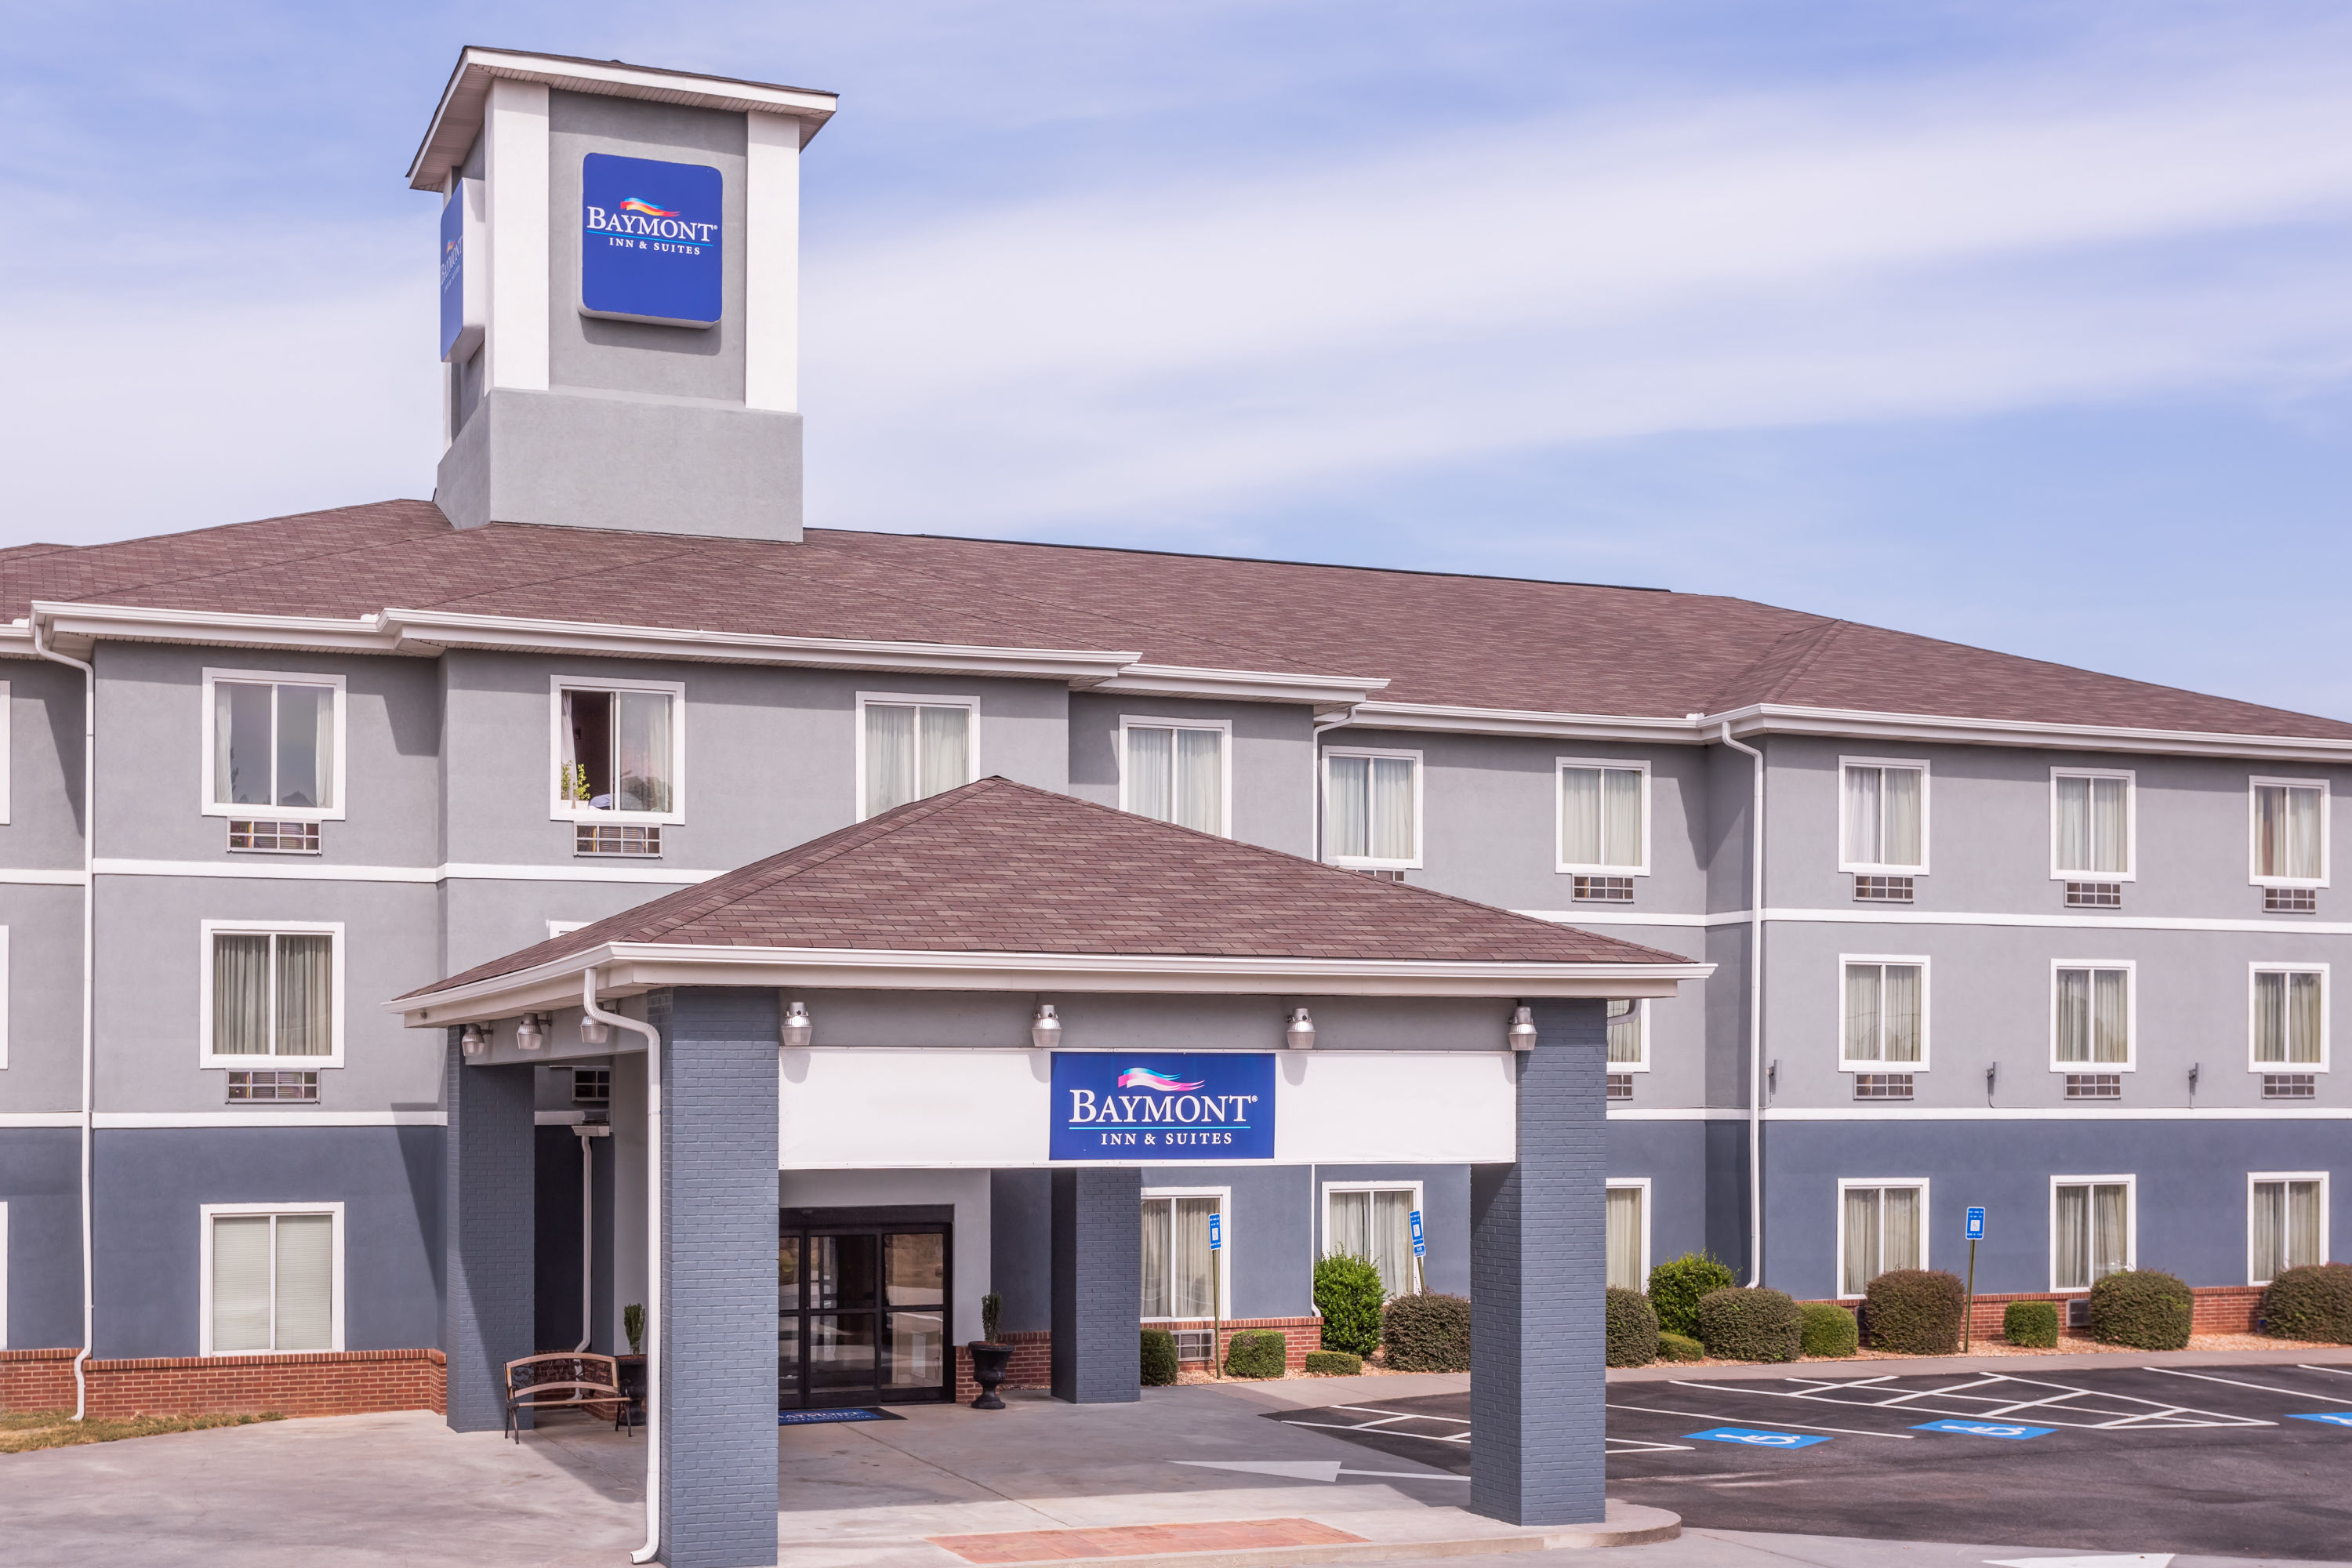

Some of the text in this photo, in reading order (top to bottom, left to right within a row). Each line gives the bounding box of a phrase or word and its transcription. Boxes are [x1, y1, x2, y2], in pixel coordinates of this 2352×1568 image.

[609, 237, 700, 256] INN & SUITES
[1101, 1132, 1232, 1145] INN & SUITES
